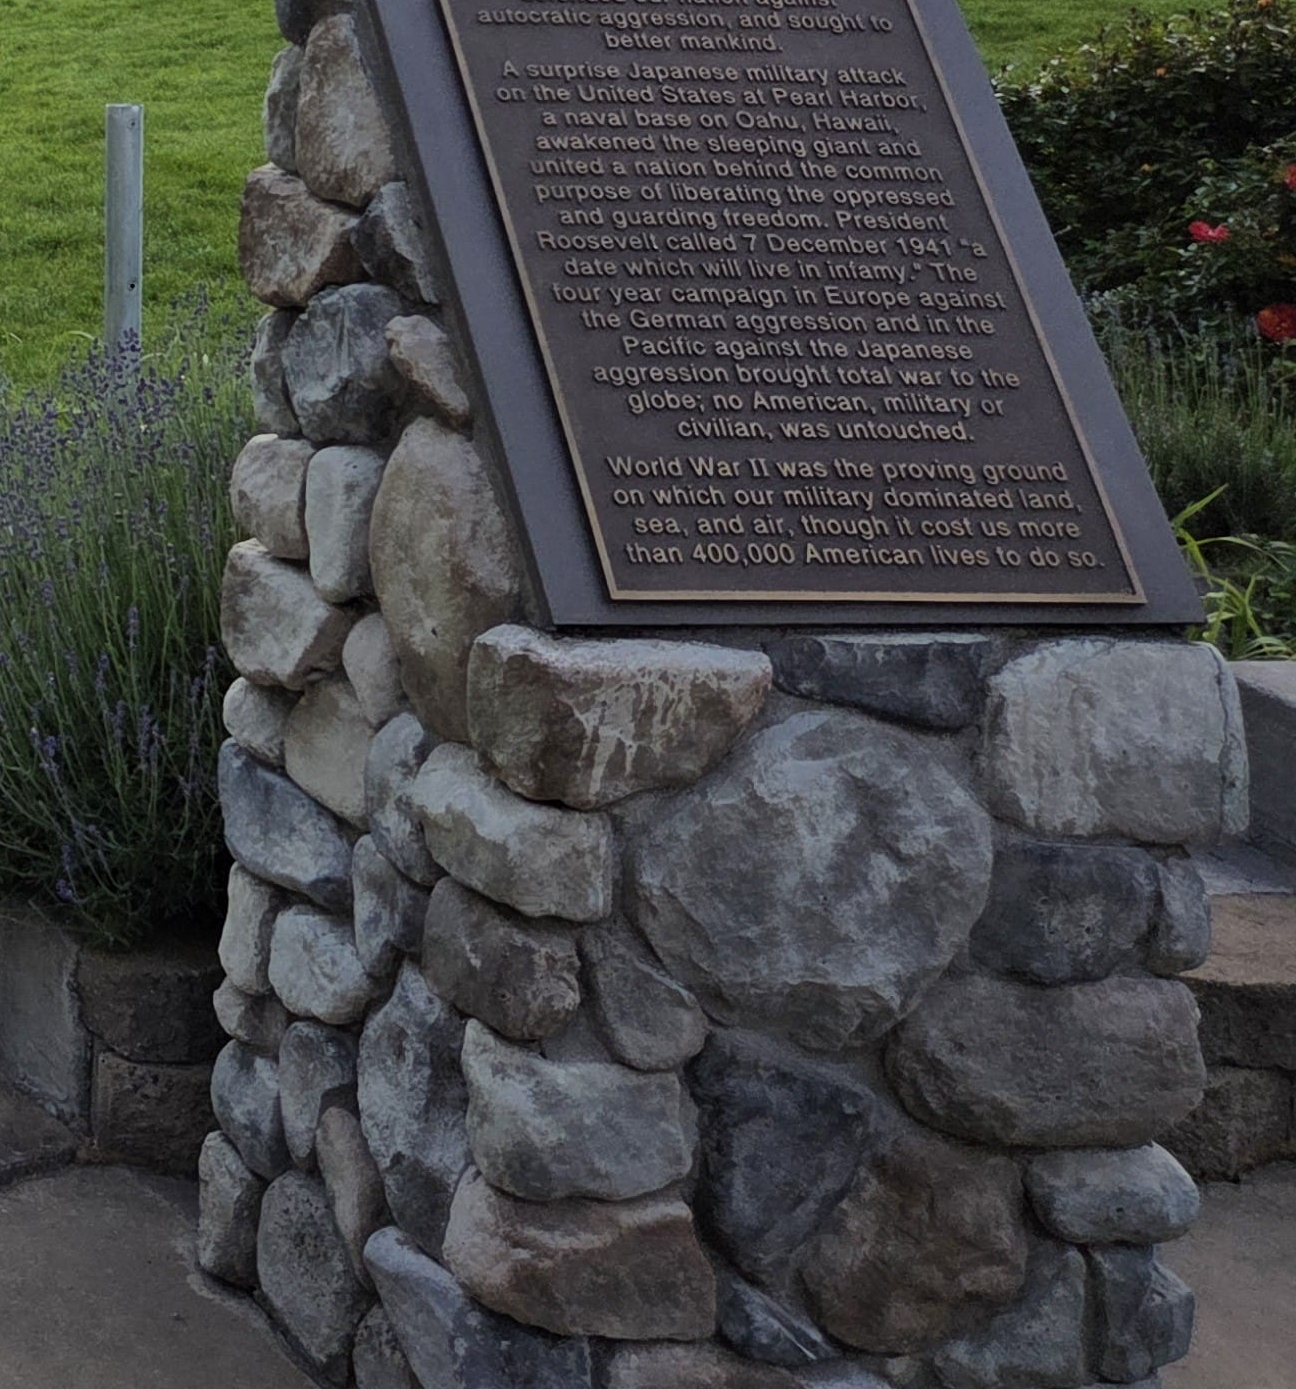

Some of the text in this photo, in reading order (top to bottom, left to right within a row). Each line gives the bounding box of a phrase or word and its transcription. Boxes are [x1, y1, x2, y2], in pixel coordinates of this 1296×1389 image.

[604, 31, 784, 51] better mankind.
[503, 59, 907, 86] A surprise Japanese military attack
[542, 108, 900, 134] a naval base on Oahu, Hawaii,
[537, 133, 922, 158] awakened the sleeping giant and
[559, 206, 949, 230] and guarding freedom. President
[536, 230, 659, 250] Roosevelt
[666, 231, 738, 251] called
[742, 232, 758, 252] 7
[766, 232, 888, 254] December
[896, 236, 952, 255] 1941
[552, 282, 1007, 311] four year campaign in Europe against
[622, 335, 973, 362] Pacific against the Japanese
[628, 389, 1004, 417] globe; no American, military or
[678, 416, 975, 441] civilian, was untouched.
[607, 455, 1069, 485] World War II was the proving ground
[613, 484, 1083, 512] on which our military dominated land,
[626, 542, 1106, 567] than 400,000 American lives to do so.
